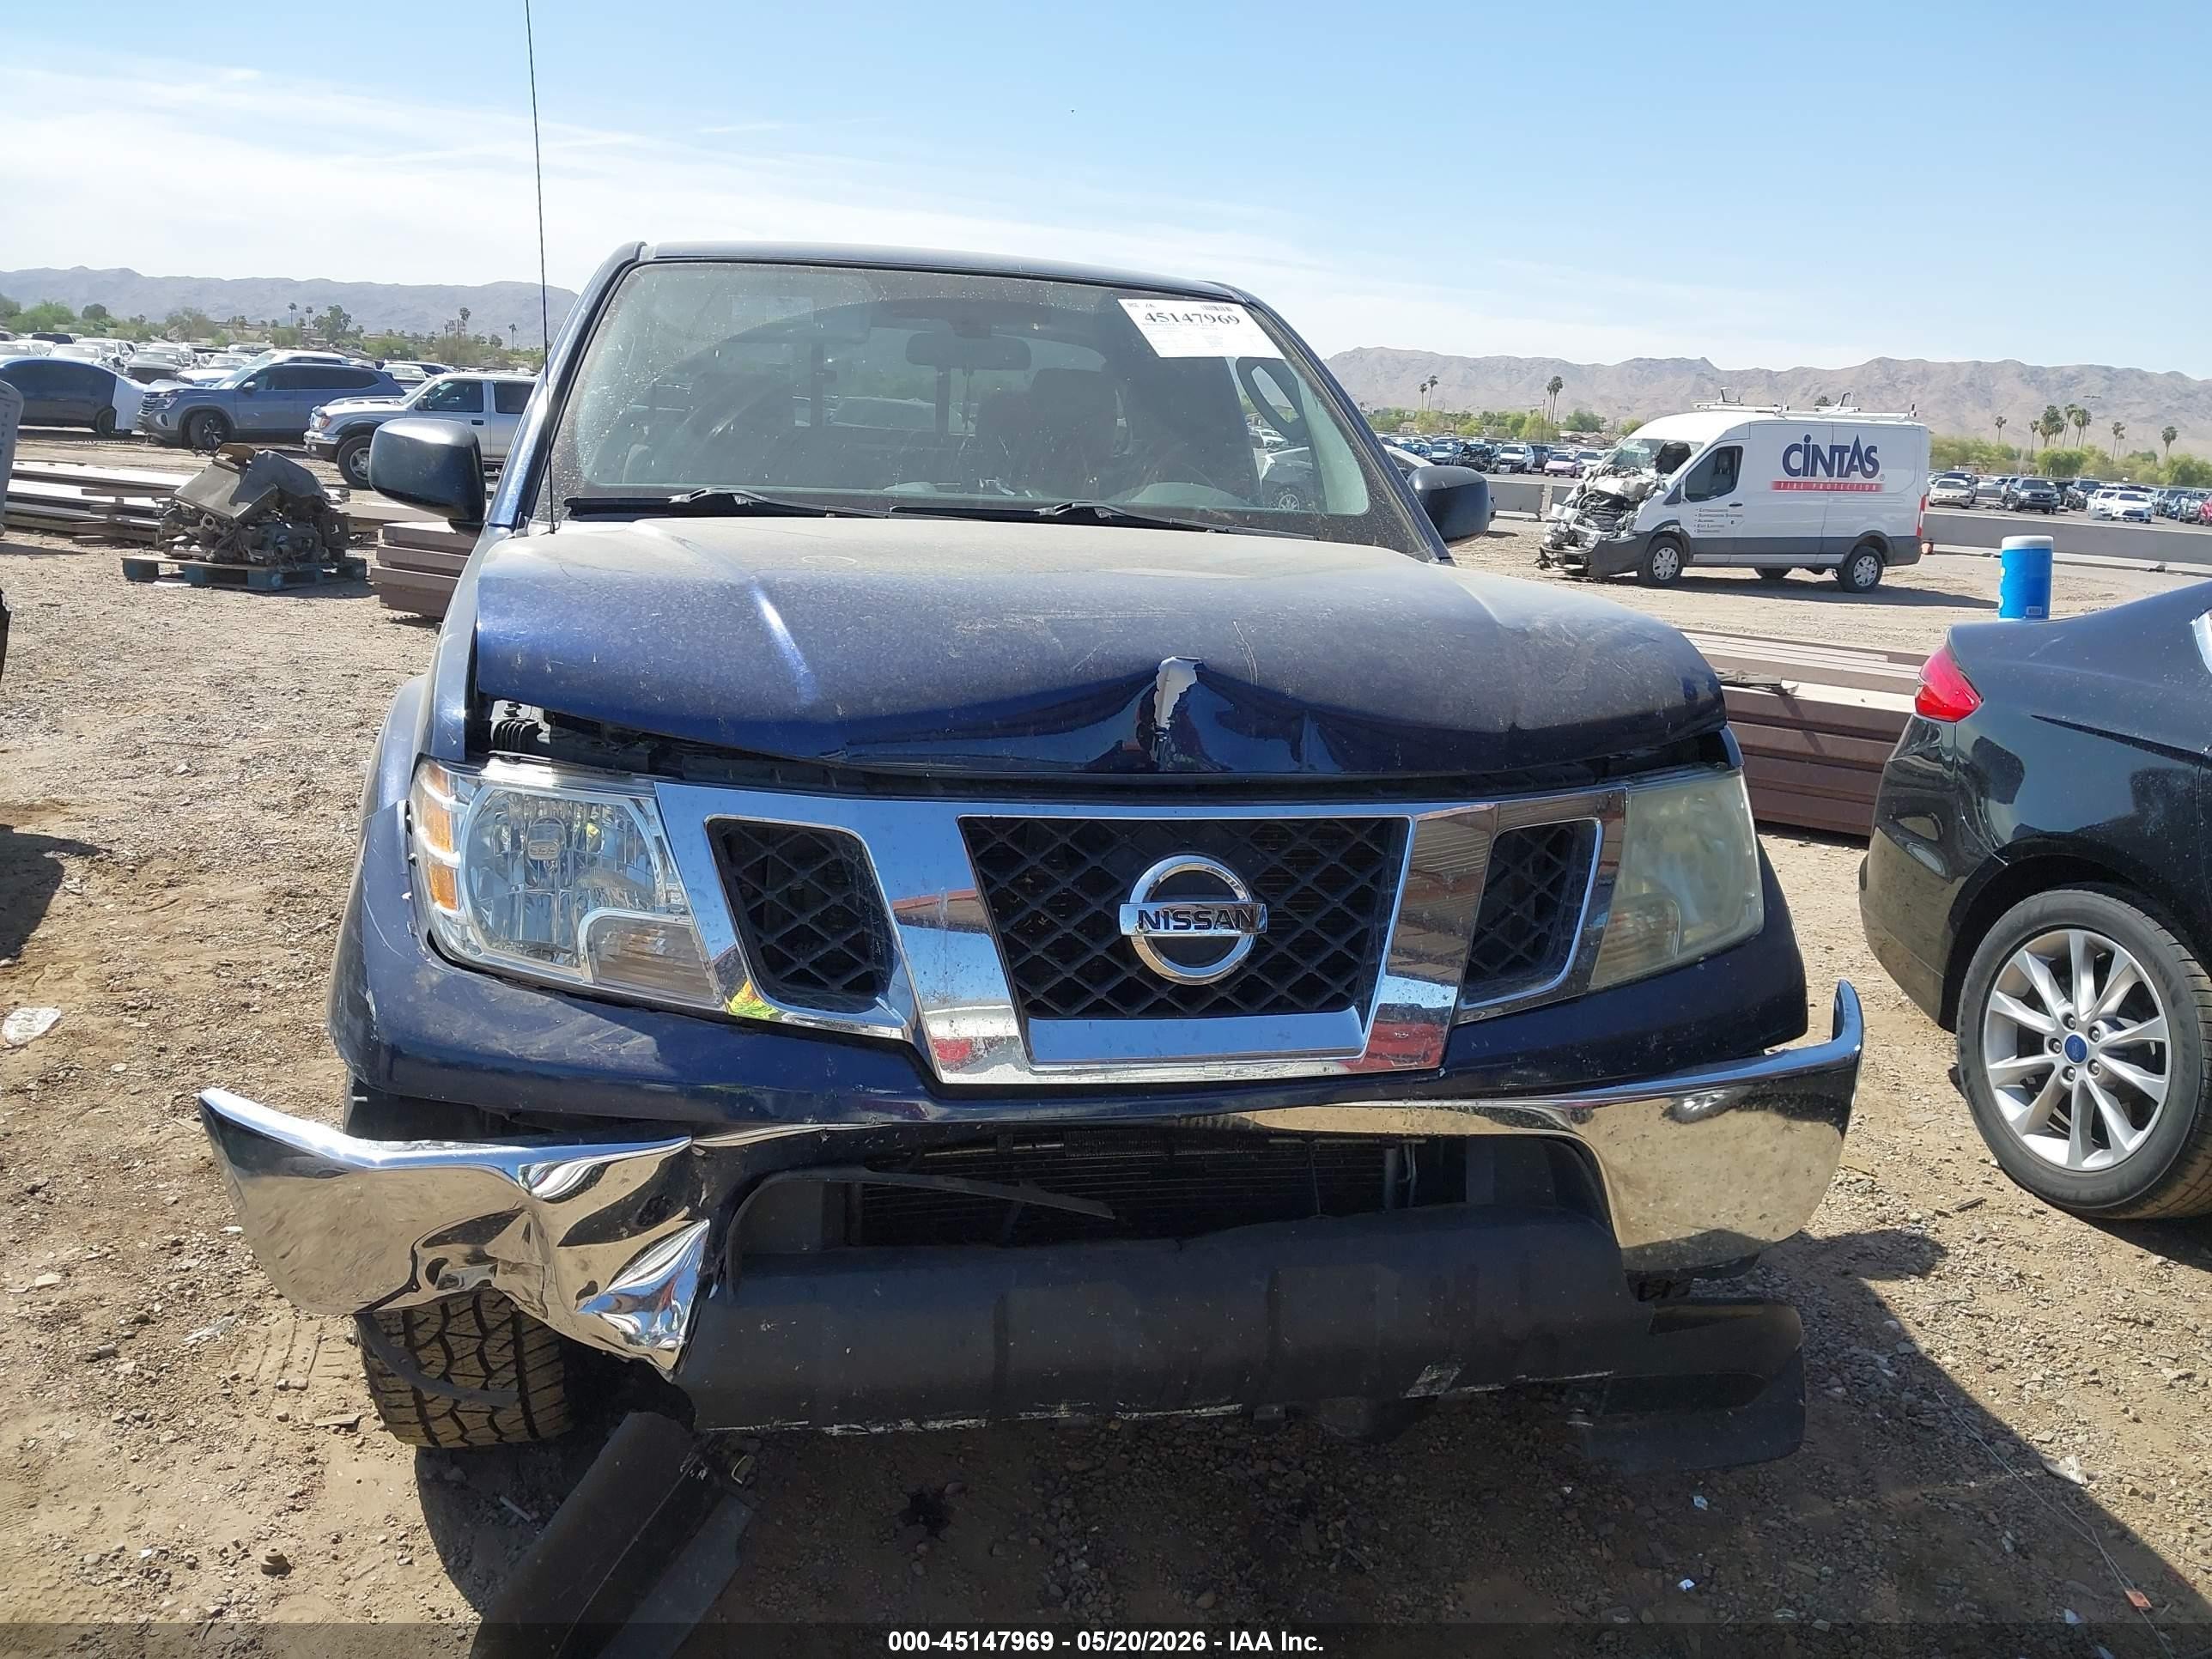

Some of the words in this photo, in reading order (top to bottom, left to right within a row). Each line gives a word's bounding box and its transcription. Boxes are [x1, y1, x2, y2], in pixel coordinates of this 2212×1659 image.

[1145, 312, 1240, 325] 45147969
[1813, 483, 1877, 491] PROTECTION
[1138, 908, 1254, 930] NISSAN
